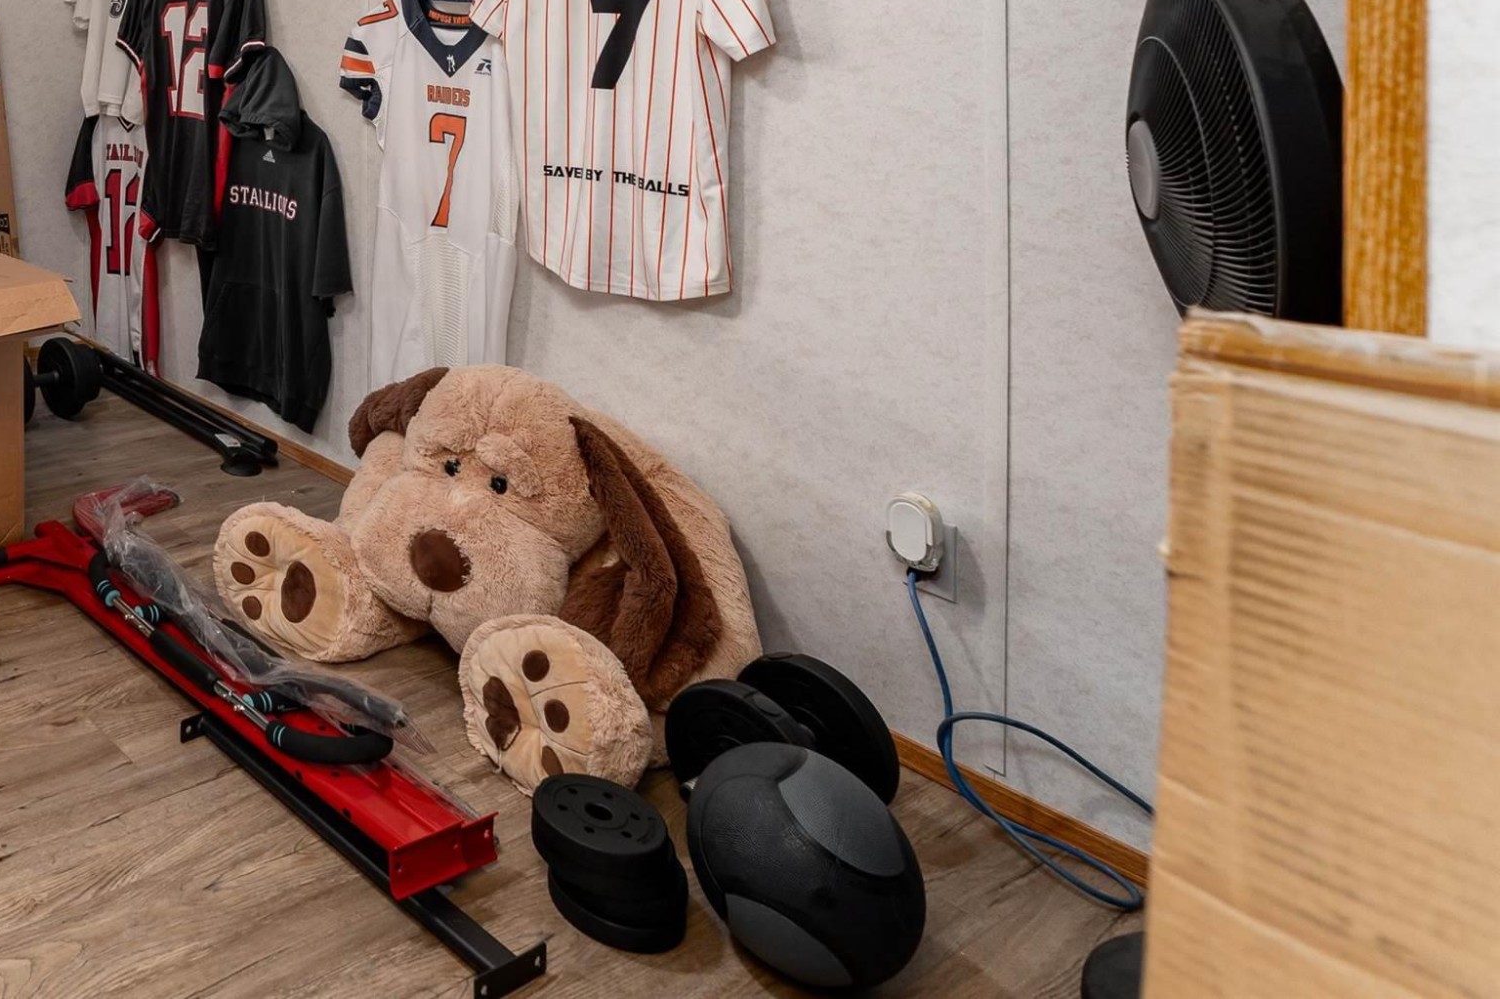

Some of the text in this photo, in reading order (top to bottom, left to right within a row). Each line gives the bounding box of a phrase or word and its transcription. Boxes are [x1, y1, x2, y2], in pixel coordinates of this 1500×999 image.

[428, 112, 467, 228] 7
[585, 168, 603, 181] BY
[613, 171, 637, 185] THE
[638, 177, 690, 197] BALLS
